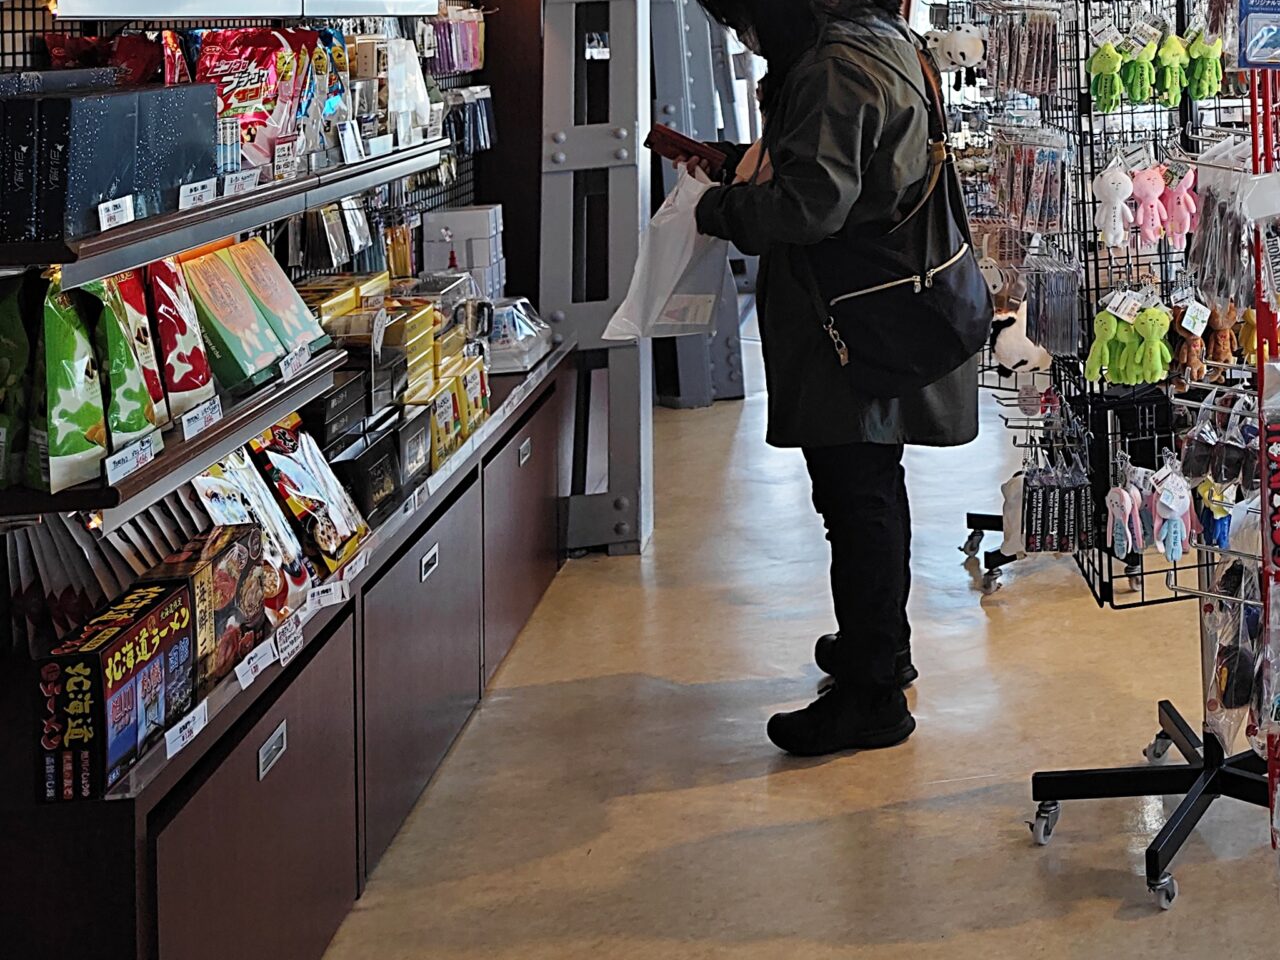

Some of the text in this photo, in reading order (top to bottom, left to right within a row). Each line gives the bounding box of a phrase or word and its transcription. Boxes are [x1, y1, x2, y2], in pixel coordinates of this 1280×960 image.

[221, 68, 270, 96] ブラック
[63, 661, 95, 748] 北海道
